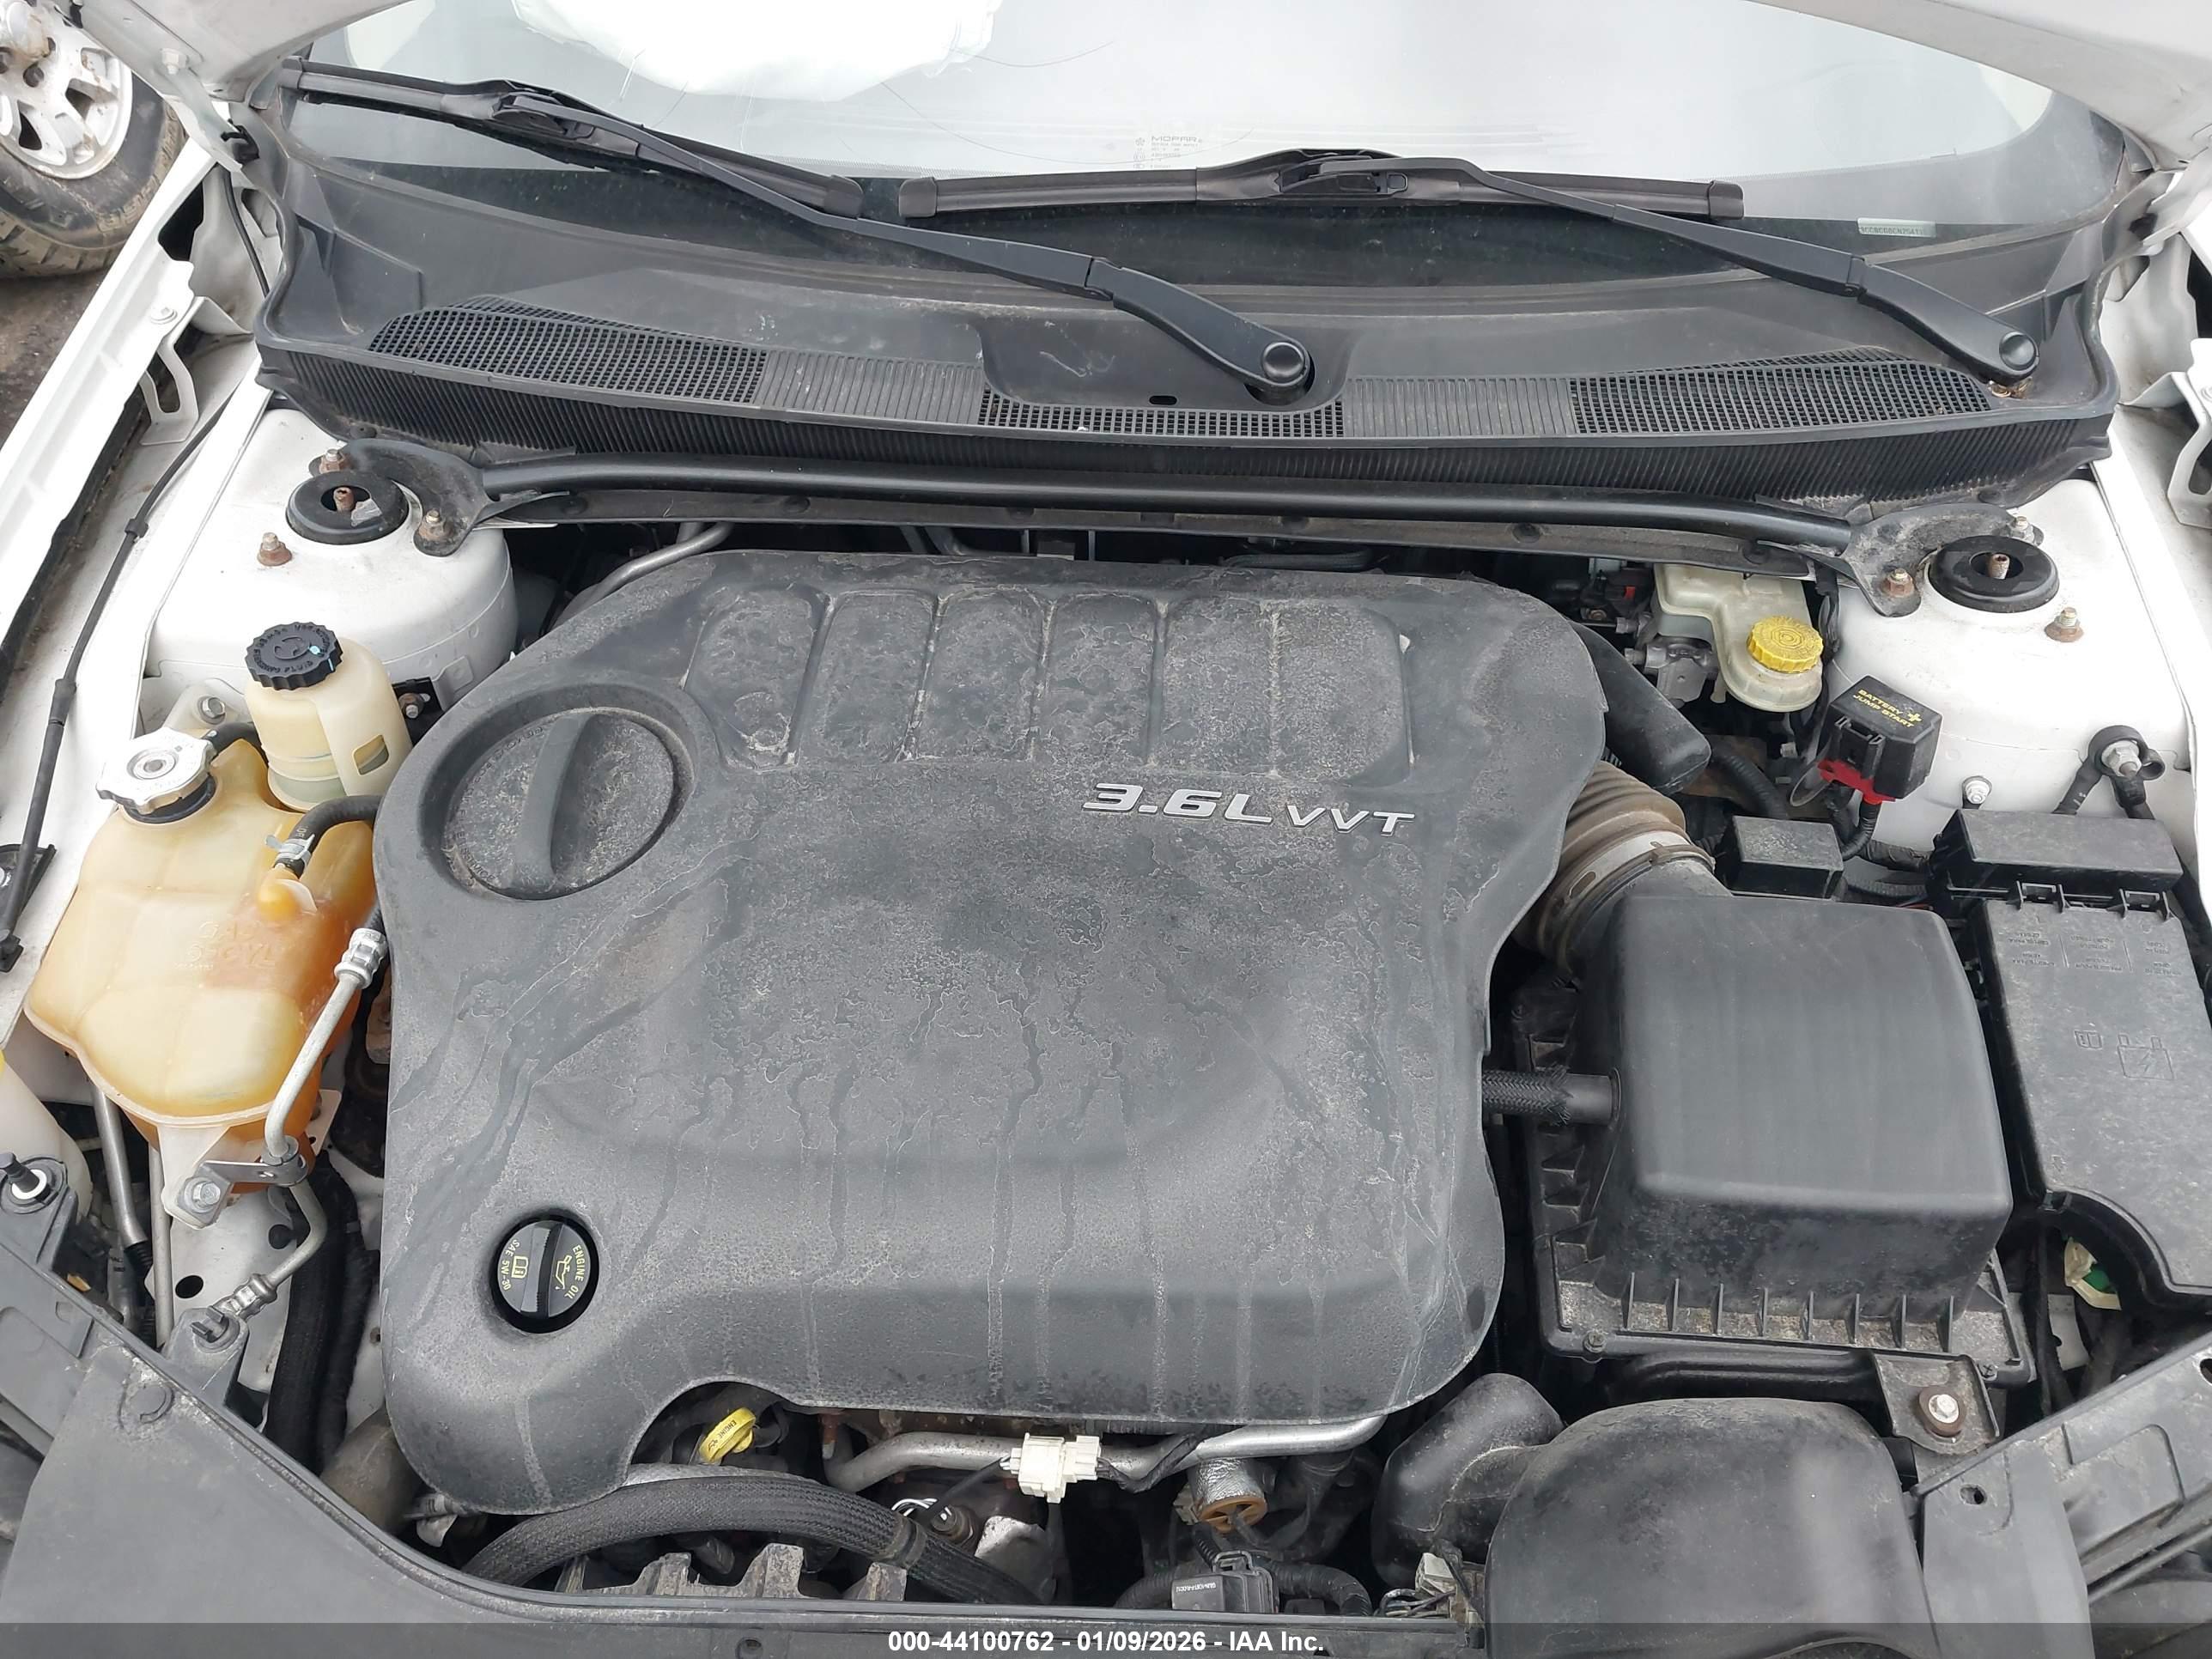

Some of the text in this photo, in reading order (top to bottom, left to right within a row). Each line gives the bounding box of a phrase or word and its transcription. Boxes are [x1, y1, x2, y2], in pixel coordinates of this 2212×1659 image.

[1852, 694, 1915, 728] JUMP START
[1858, 689, 1904, 715] BATTERY
[1082, 782, 1417, 837] 3.6L VVT
[501, 1239, 520, 1291] SAE 5W-30
[564, 1244, 586, 1299] ENGINE OIL
[719, 1419, 737, 1438] ENGINE
